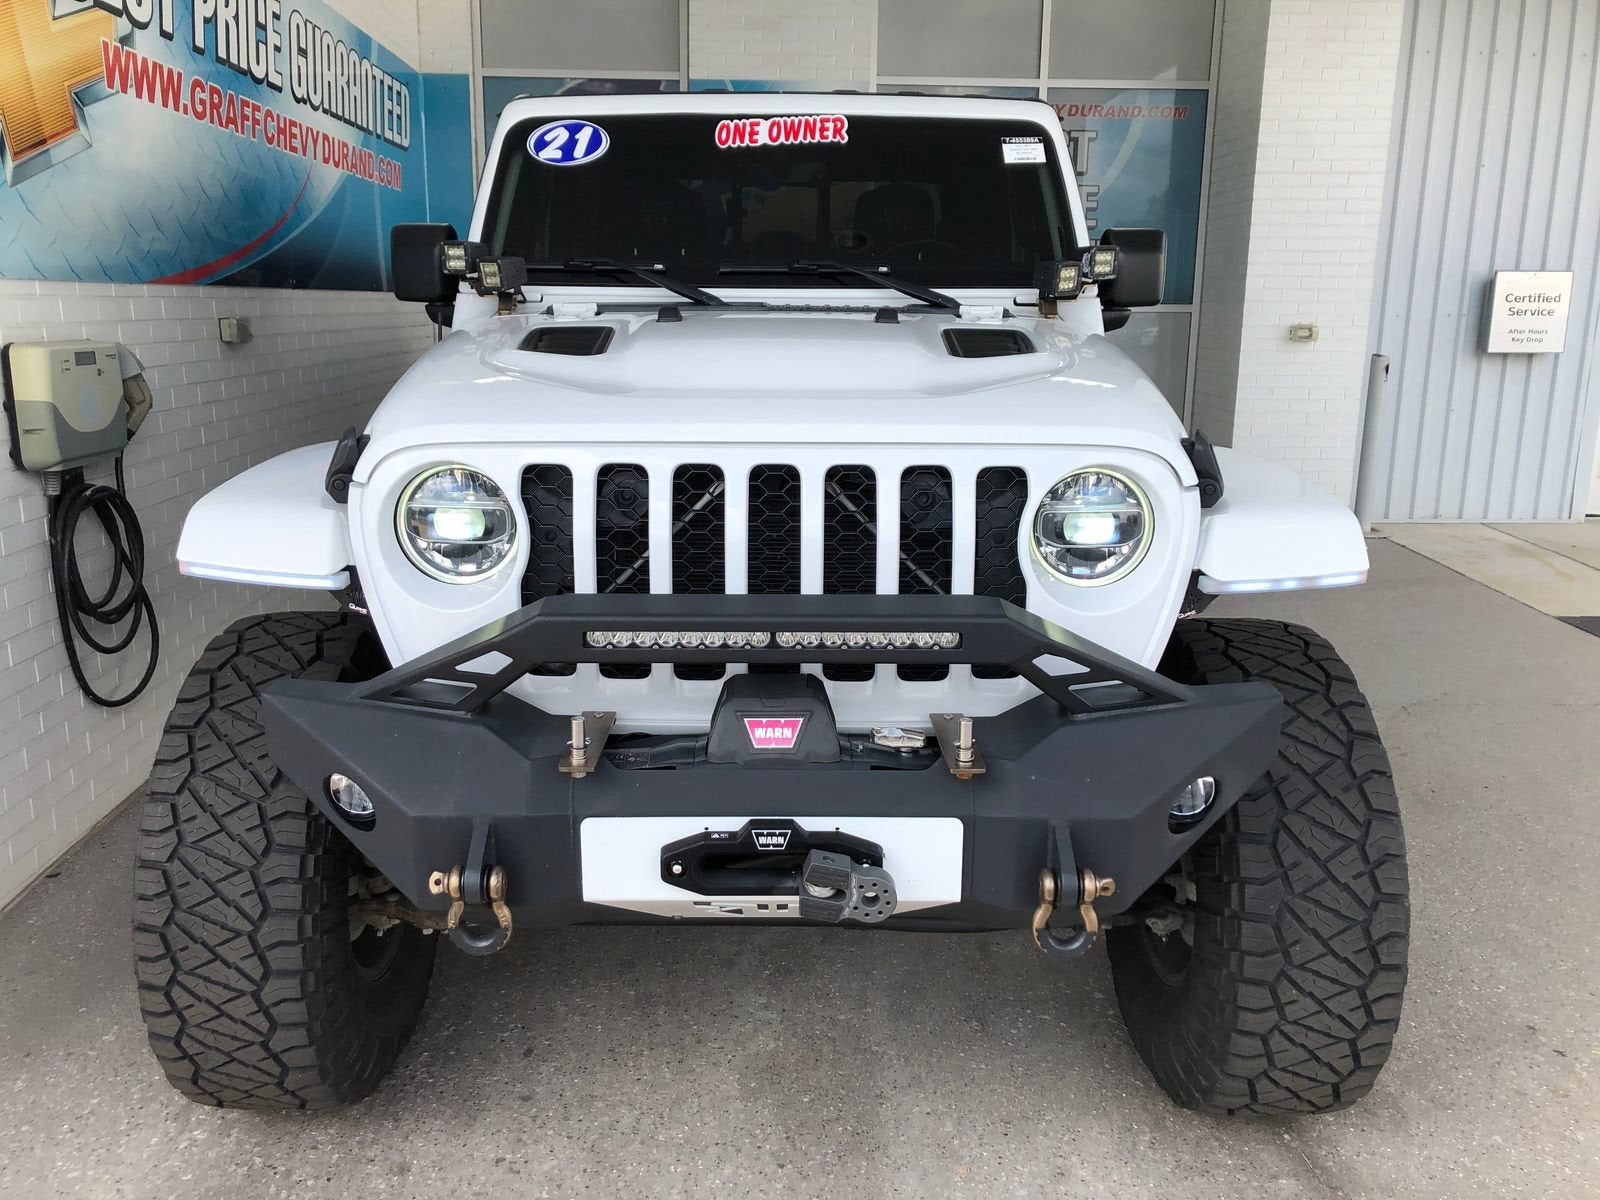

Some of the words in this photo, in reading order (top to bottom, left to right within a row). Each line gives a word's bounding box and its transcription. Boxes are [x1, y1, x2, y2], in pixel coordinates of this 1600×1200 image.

[289, 10, 411, 151] GUARANTEED
[101, 38, 402, 192] WWW.GRAFFCHEVYDURAND.COM
[1052, 103, 1189, 119] YDURAND.COM
[716, 120, 760, 147] ONE
[767, 115, 848, 144] OWNER
[538, 126, 594, 159] 21
[1505, 293, 1562, 303] Certified
[1508, 306, 1555, 317] Service
[754, 727, 793, 739] WARN
[758, 836, 785, 845] WARN
